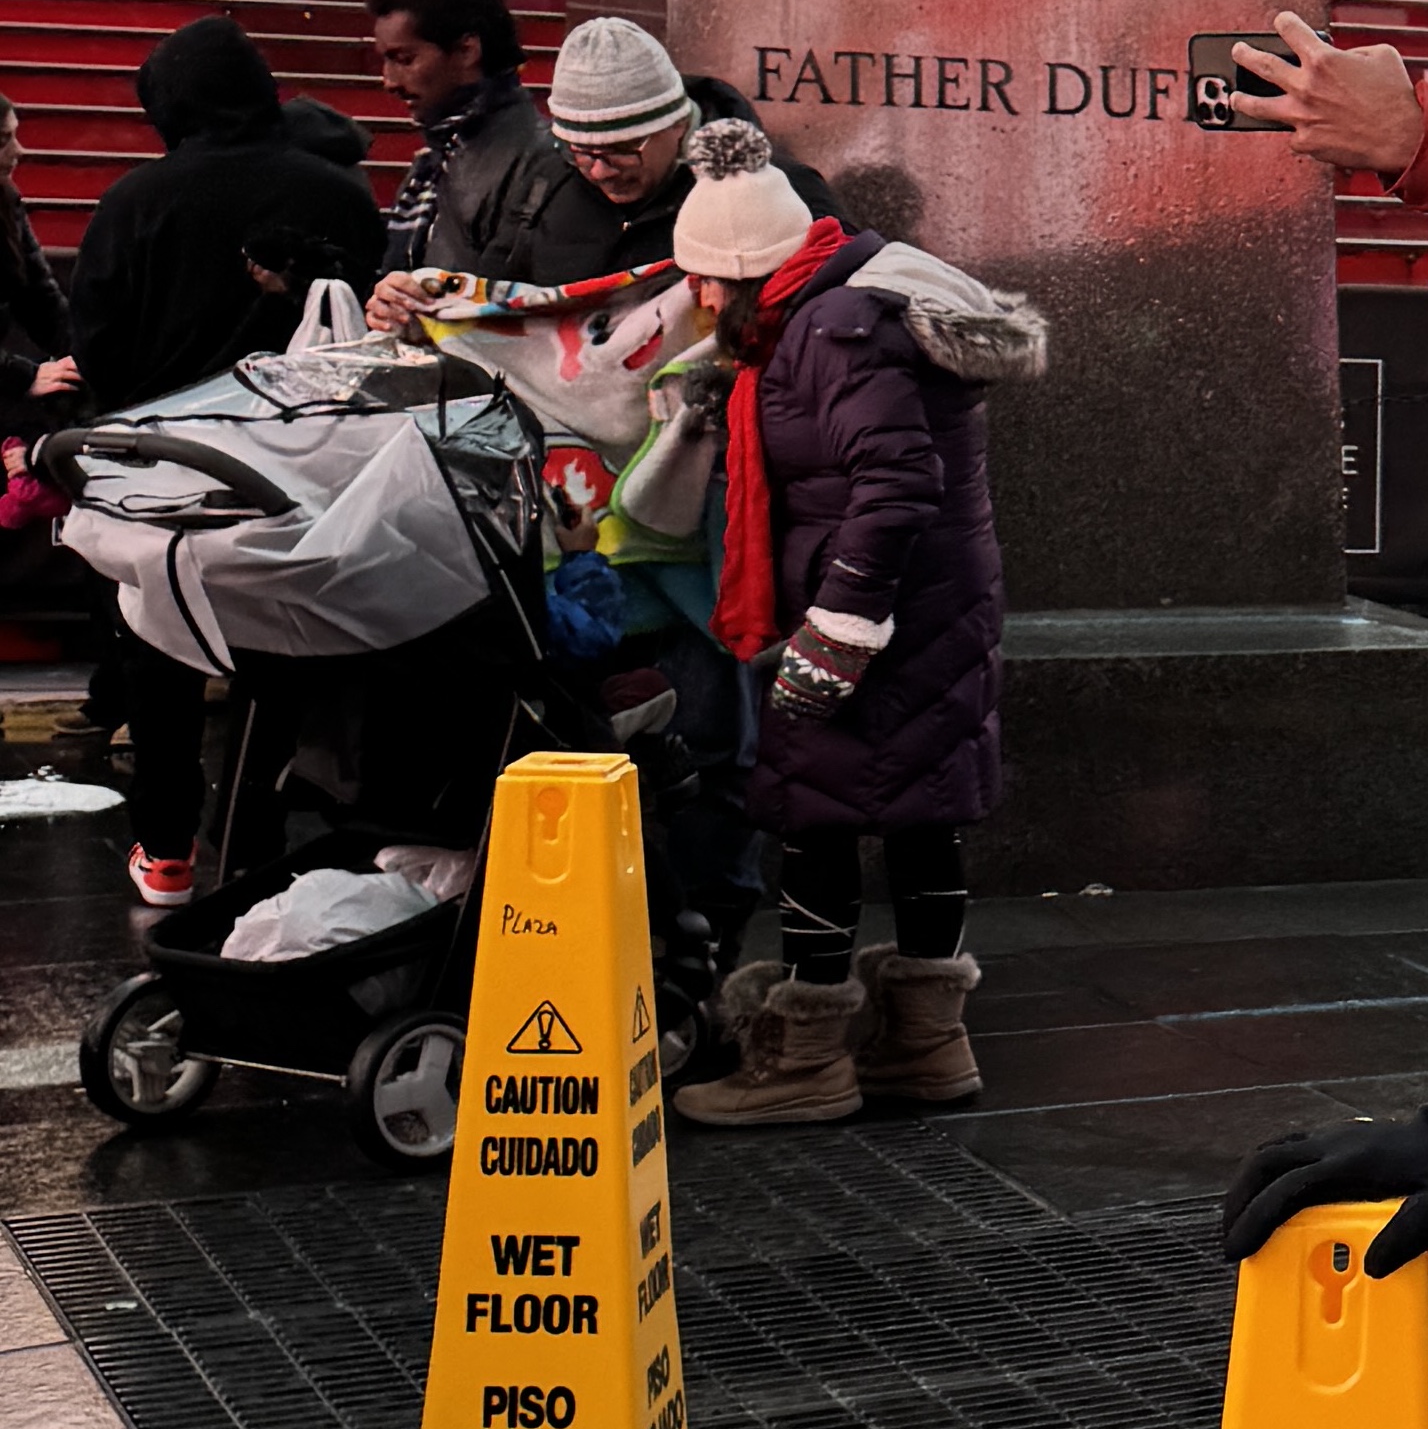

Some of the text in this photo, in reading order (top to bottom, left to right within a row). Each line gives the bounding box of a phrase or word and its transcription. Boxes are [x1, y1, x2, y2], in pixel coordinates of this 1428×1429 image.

[753, 46, 1020, 116] FATHER
[485, 1075, 599, 1115] CAUTION
[480, 1136, 599, 1177] CUIDADO
[491, 1234, 580, 1277] WET
[466, 1293, 599, 1335] FLOOR
[482, 1385, 577, 1429] PISO
